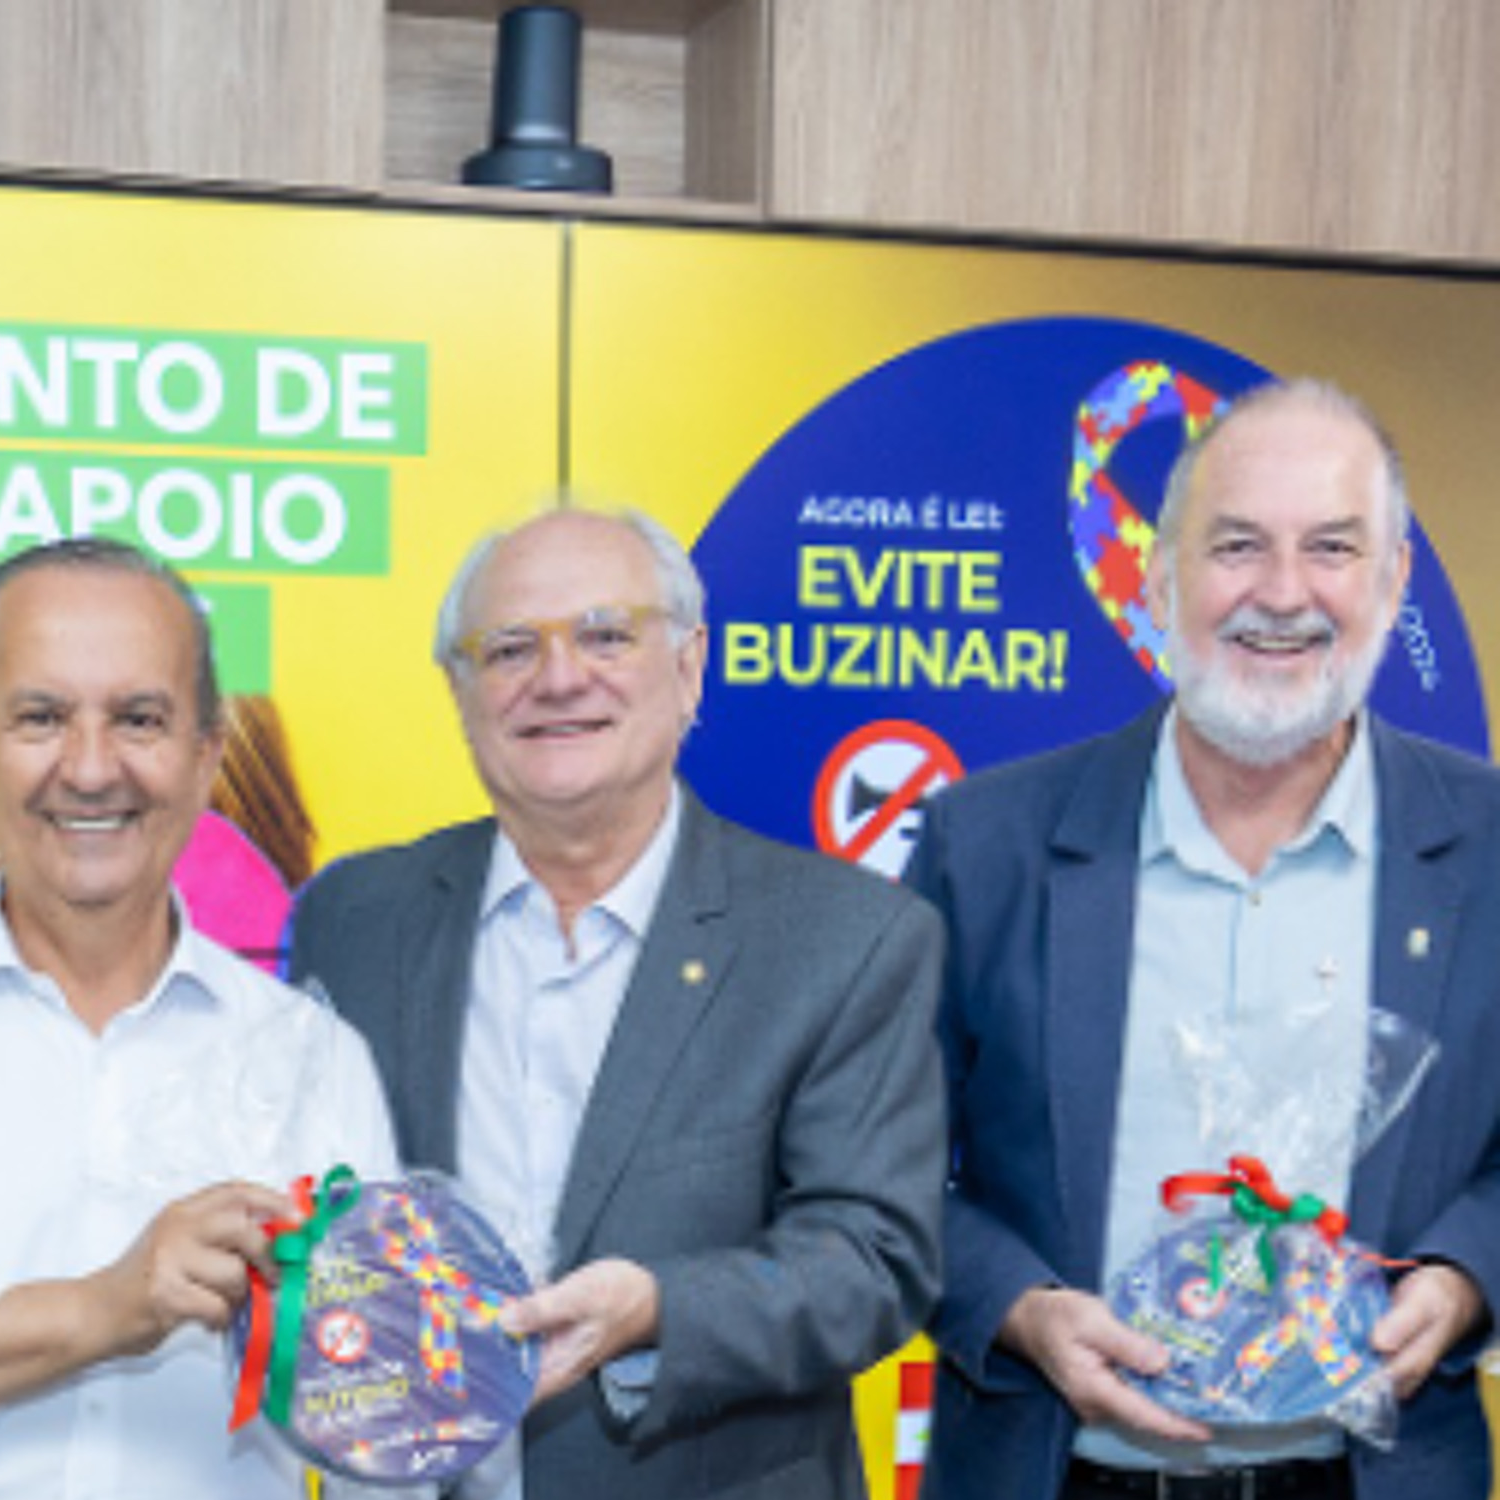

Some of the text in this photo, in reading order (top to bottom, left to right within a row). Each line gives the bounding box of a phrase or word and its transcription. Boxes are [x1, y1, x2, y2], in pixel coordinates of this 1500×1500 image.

[257, 346, 396, 441] DE
[797, 494, 913, 529] AGORA
[920, 491, 942, 529] É
[798, 544, 1002, 613] EVITE
[724, 621, 1069, 692] BUZINAR!
